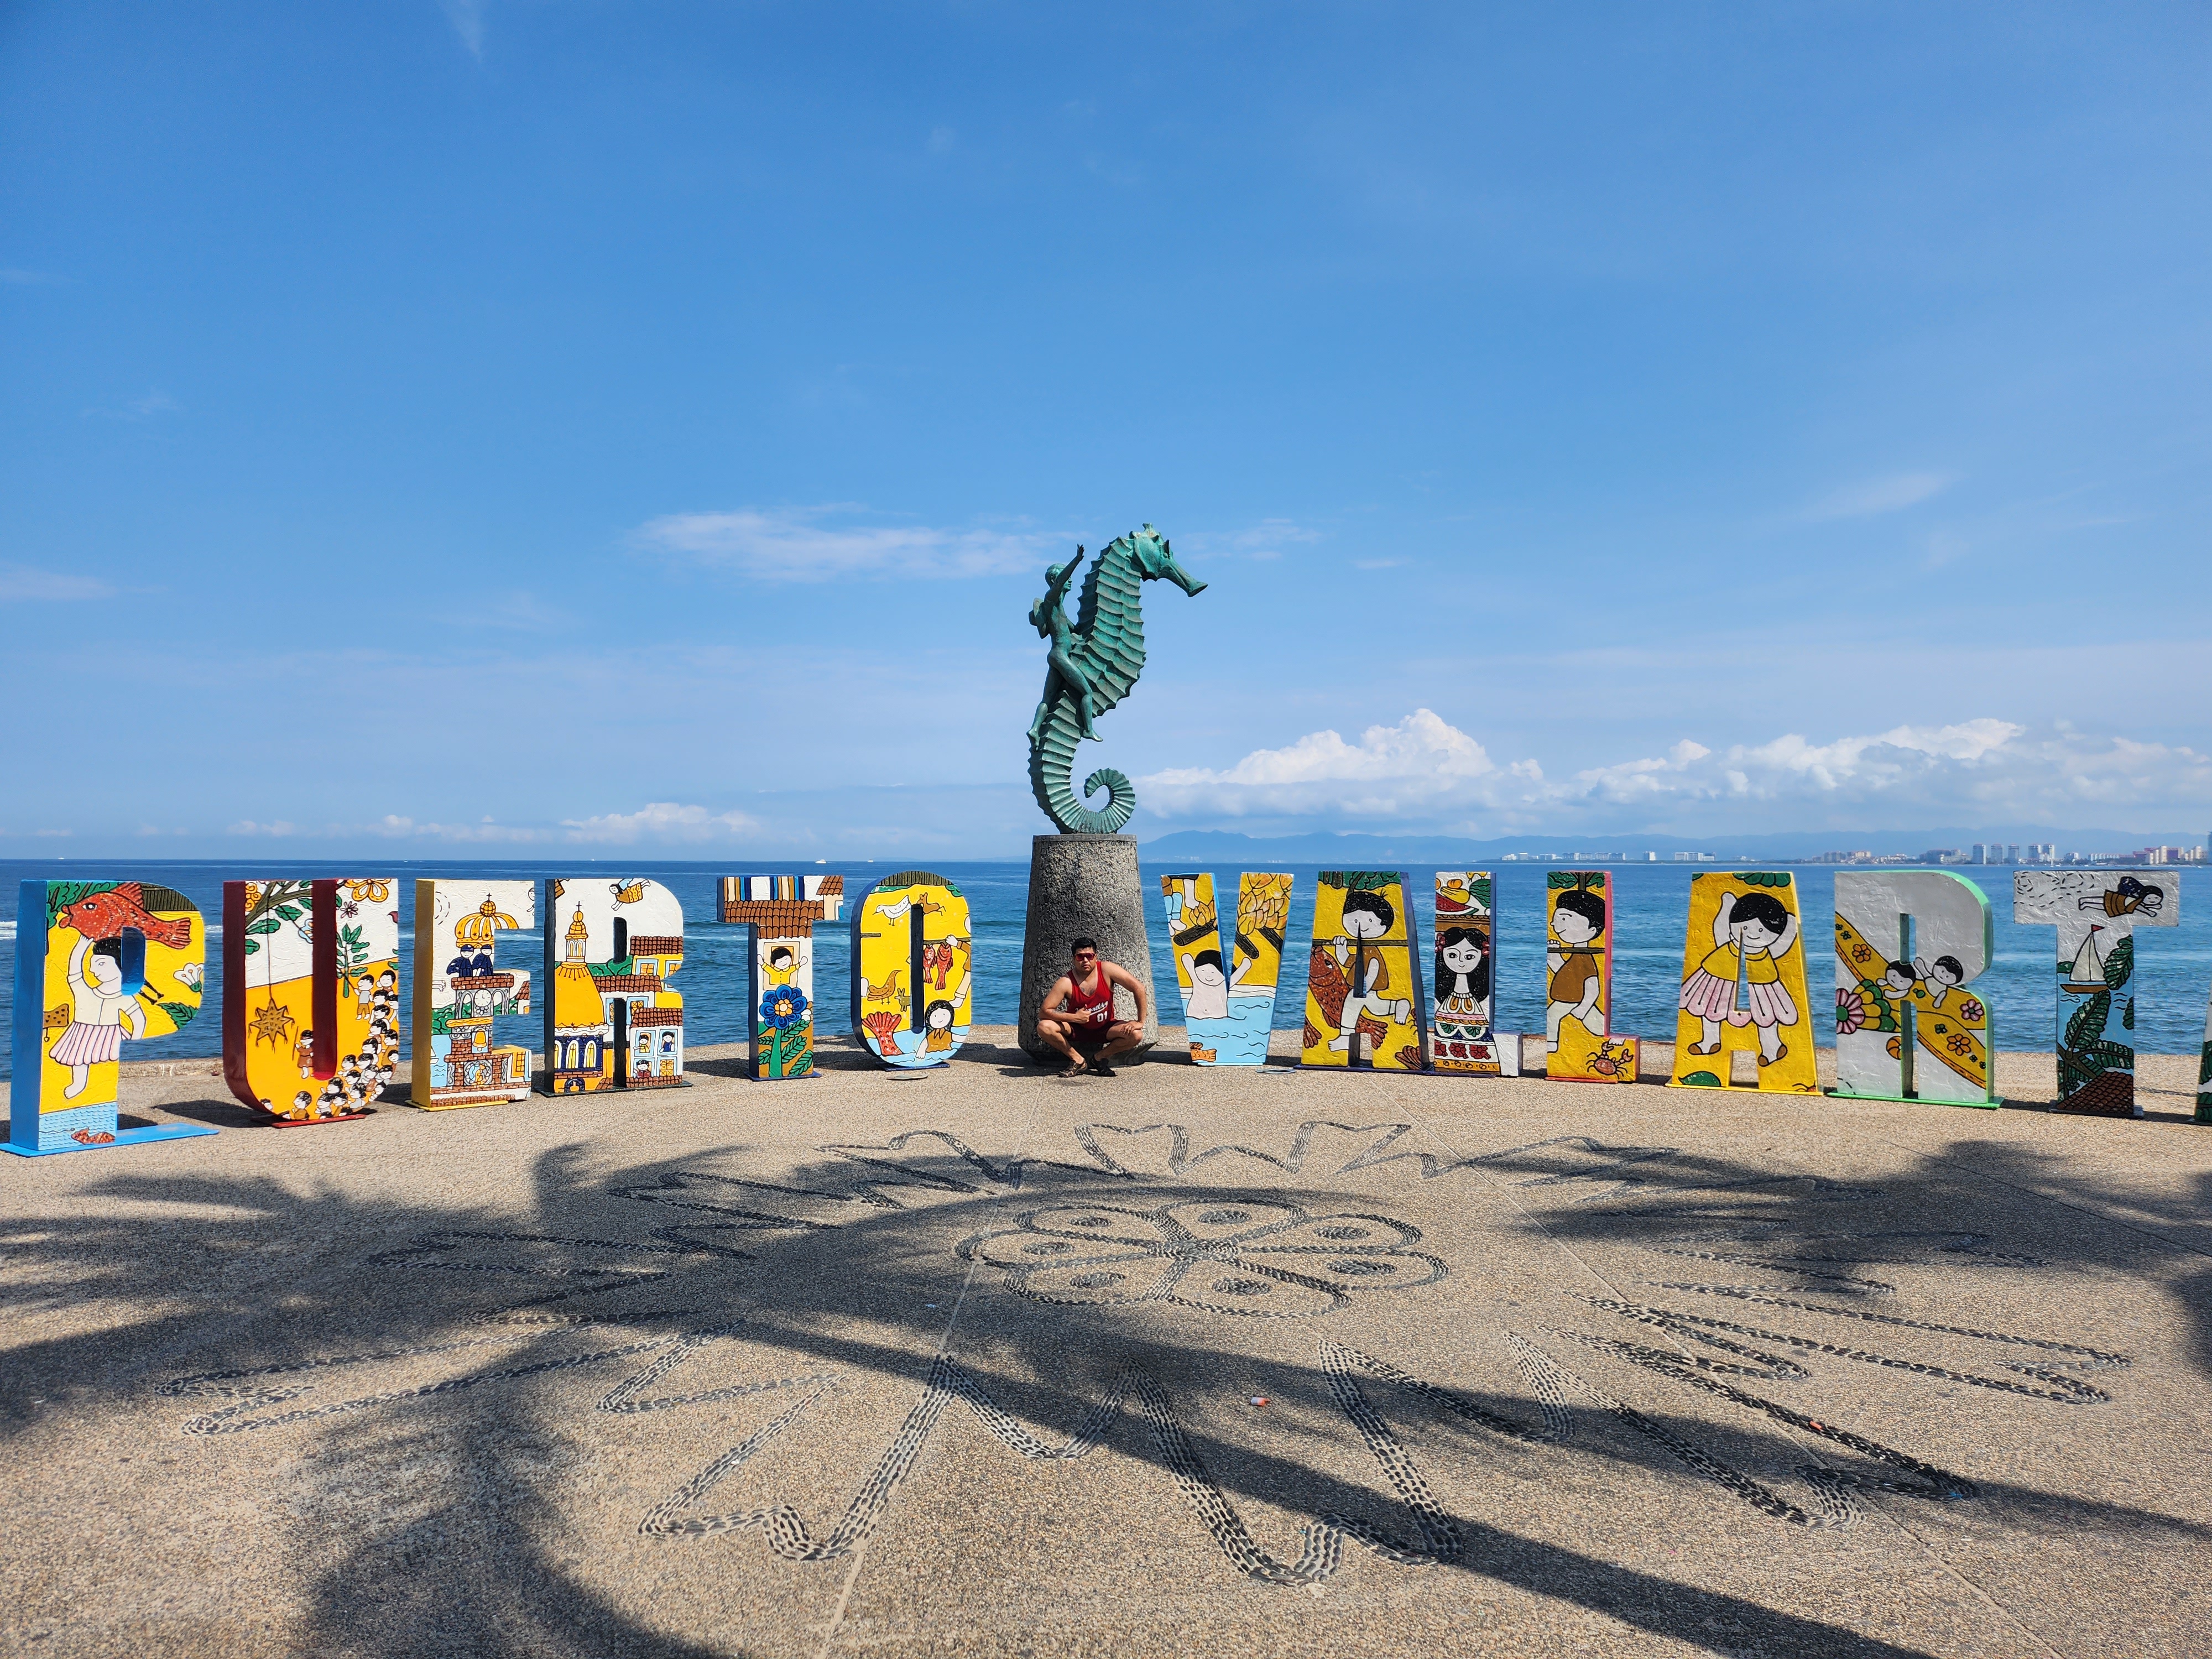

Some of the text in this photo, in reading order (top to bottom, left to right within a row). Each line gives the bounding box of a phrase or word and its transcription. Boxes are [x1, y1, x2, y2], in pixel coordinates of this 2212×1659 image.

[9, 870, 2212, 1151] PUERTO VALLART
[1097, 1010, 1108, 1022] 01
